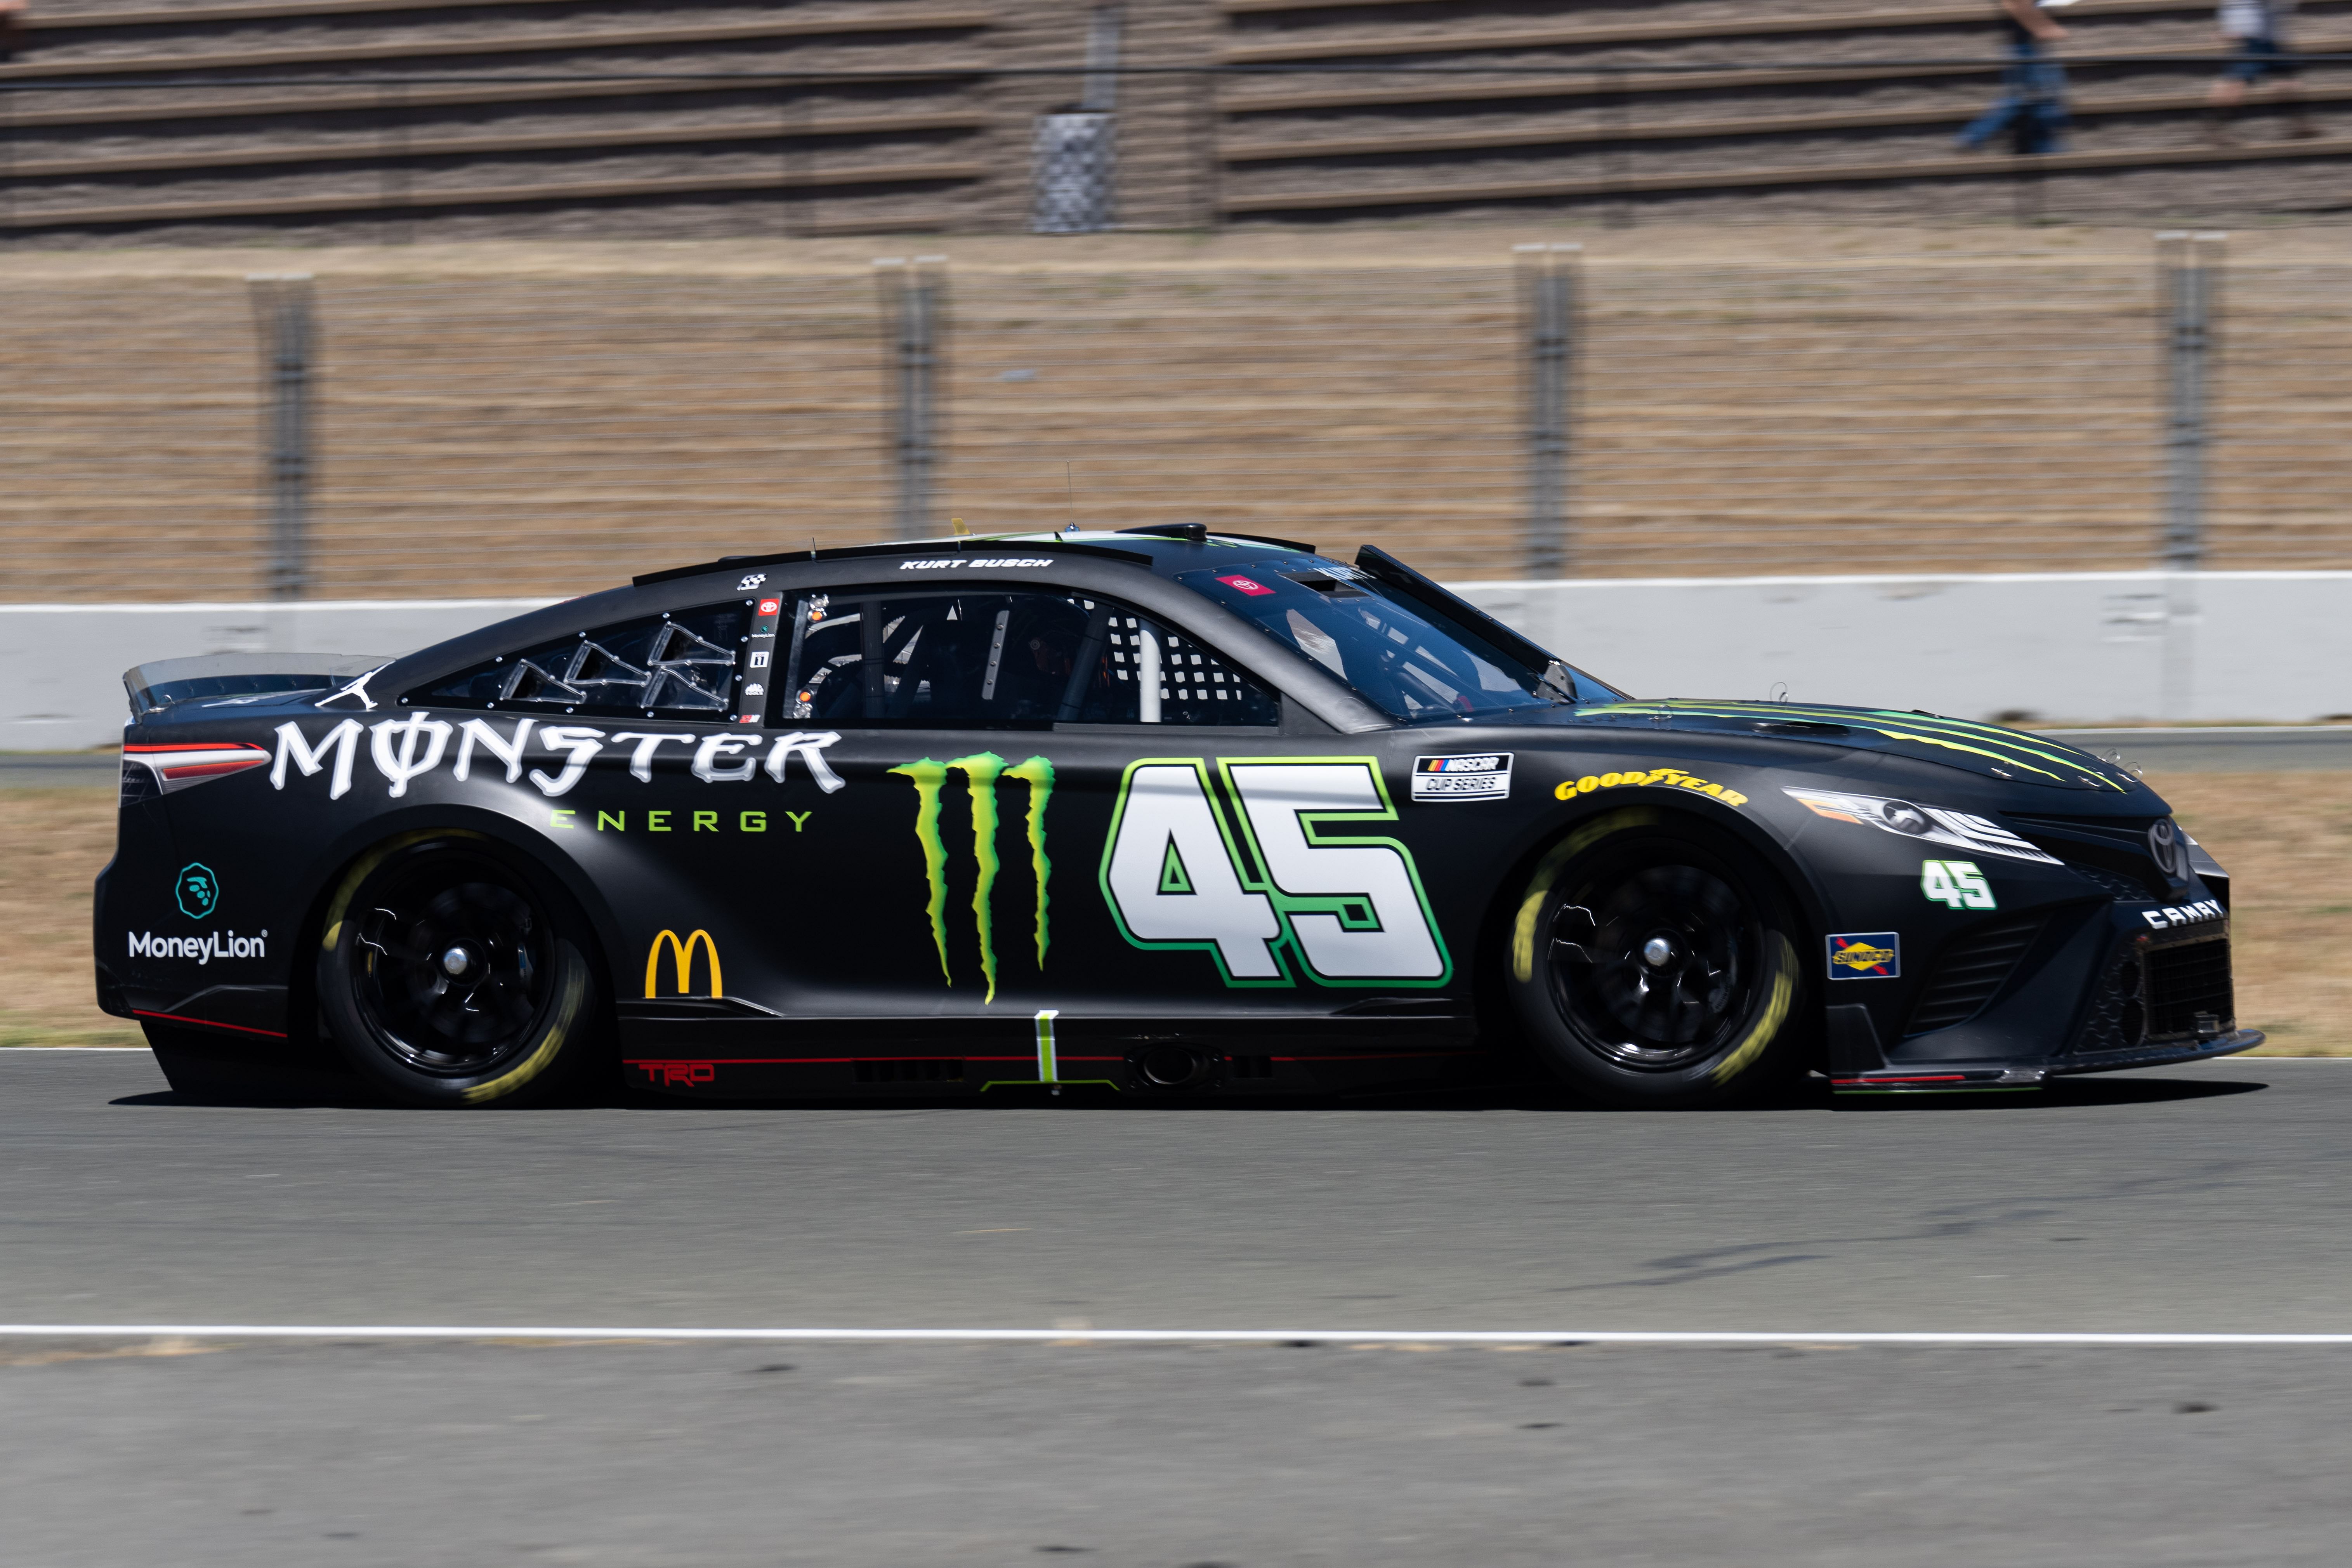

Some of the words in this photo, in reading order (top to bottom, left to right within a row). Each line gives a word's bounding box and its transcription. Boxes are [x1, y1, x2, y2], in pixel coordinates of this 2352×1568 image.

[900, 559, 967, 570] KURT
[968, 559, 1054, 568] BUSCH
[1445, 757, 1500, 772] NASCAR
[1426, 778, 1452, 790] CUP
[1453, 777, 1497, 790] SERIES
[1554, 768, 1749, 807] GOODYEAR
[549, 809, 812, 832] ENERGY
[1099, 756, 1454, 988] 45
[1921, 860, 1998, 910] 45
[1832, 949, 1894, 964] SUNOCO
[639, 1063, 715, 1087] TRD
